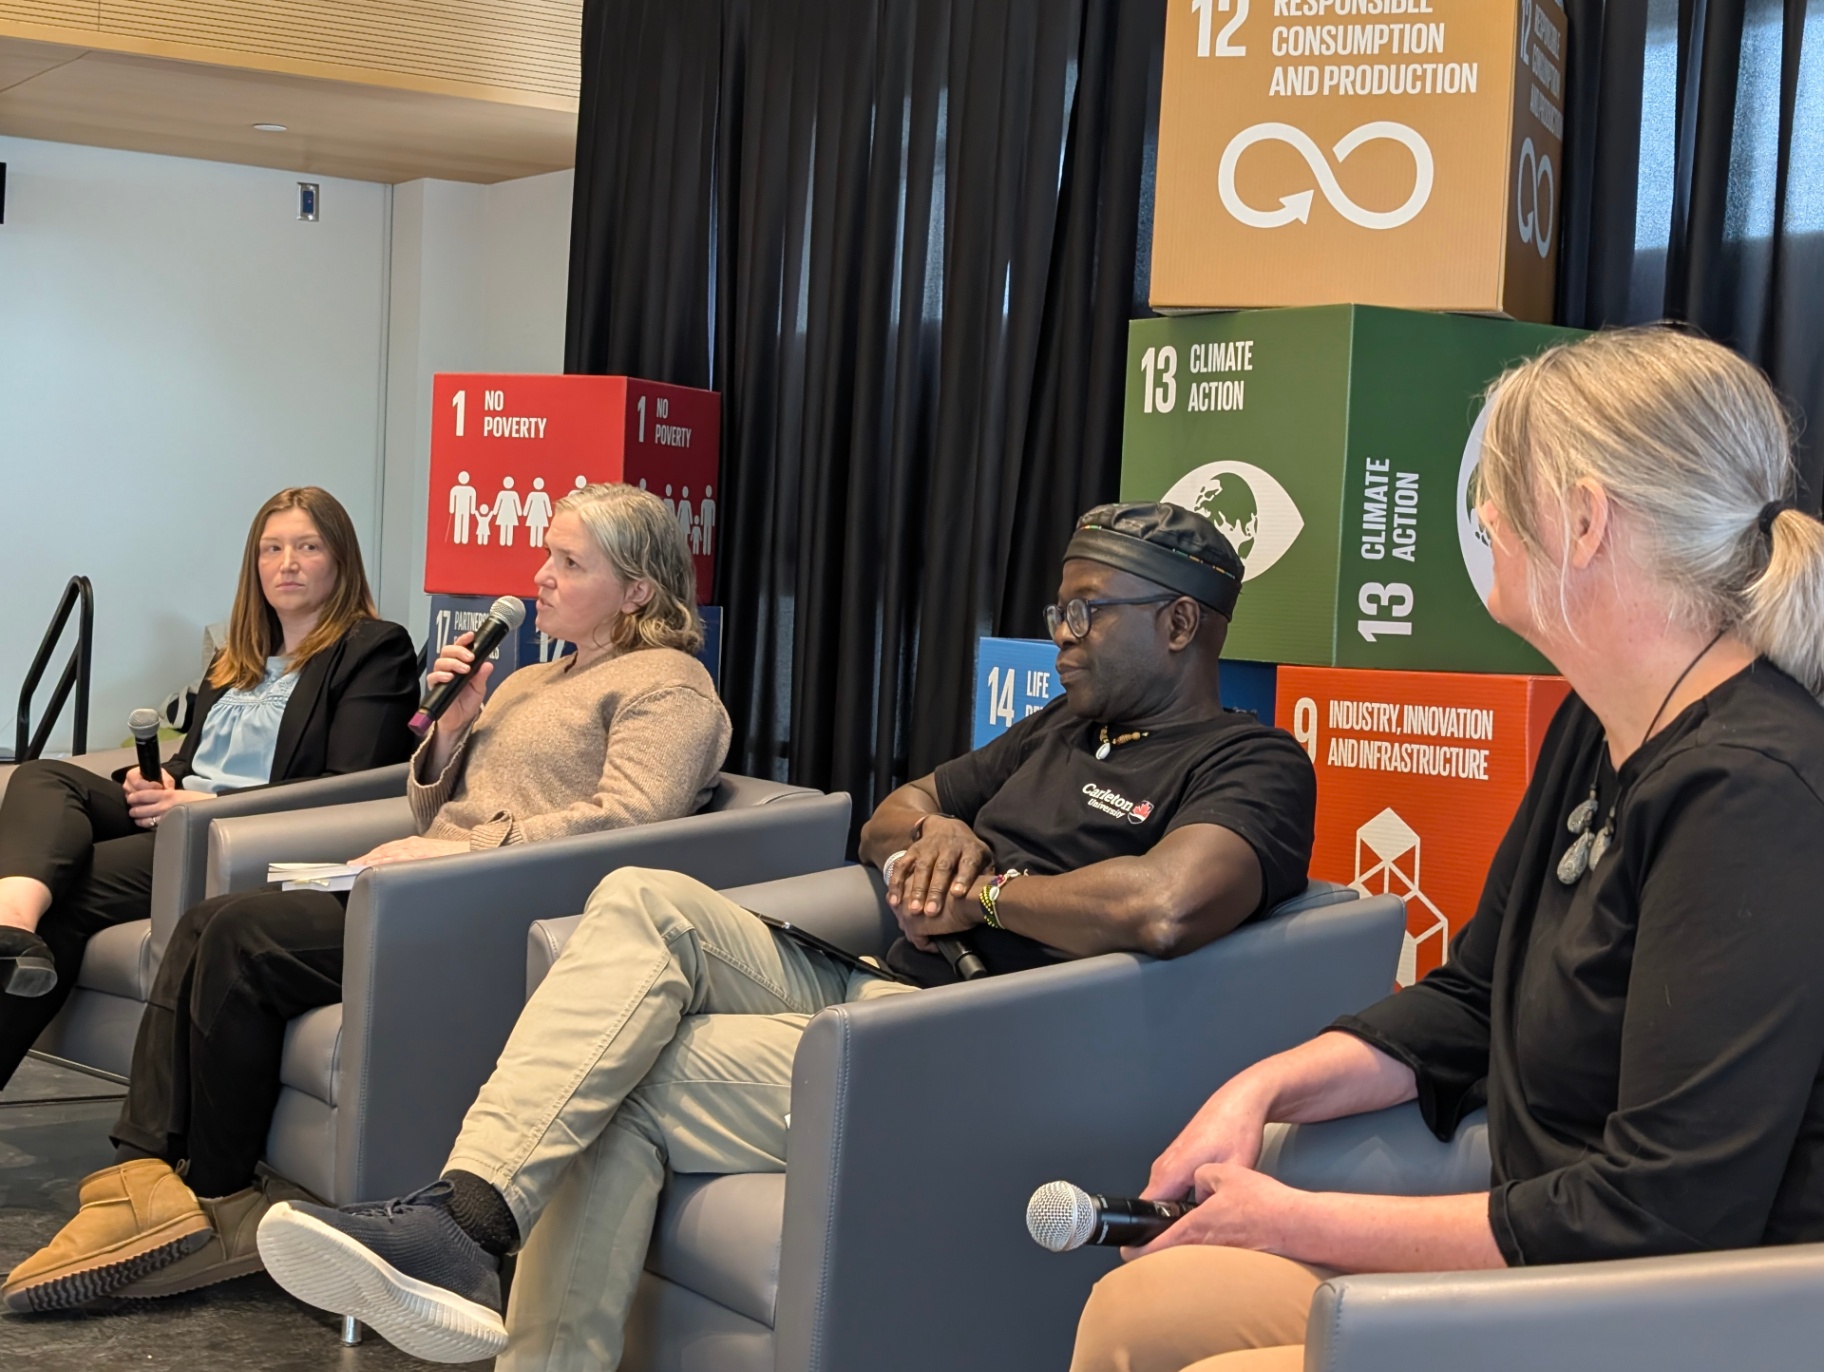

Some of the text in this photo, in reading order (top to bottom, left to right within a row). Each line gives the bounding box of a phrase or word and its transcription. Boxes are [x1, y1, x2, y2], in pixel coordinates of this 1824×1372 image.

[1191, 0, 1249, 57] 12
[1272, 23, 1445, 56] CONSUMPTION
[1269, 63, 1478, 96] AND PRODUCTION
[1190, 340, 1254, 373] CLIMATE
[1141, 346, 1177, 413] 13
[1188, 381, 1245, 412] ACTION
[452, 390, 466, 437] 1
[484, 390, 504, 411] NO
[637, 395, 646, 443] 1
[656, 397, 669, 419] NO
[483, 416, 547, 438] POVERTY
[654, 424, 692, 448] POVERTY
[1361, 457, 1390, 560] CLIMATE
[1392, 472, 1420, 562] ACTION
[436, 610, 451, 654] 17
[1358, 581, 1414, 643] 13
[988, 666, 1015, 728] 14
[1026, 670, 1050, 699] LIFE
[1294, 697, 1318, 766] 9
[1329, 700, 1494, 741] INDUSTRY, INNOVATION
[1328, 737, 1490, 780] AND INFRASTRUCTURE
[1082, 783, 1134, 812] Carleton
[1087, 798, 1126, 819] University
